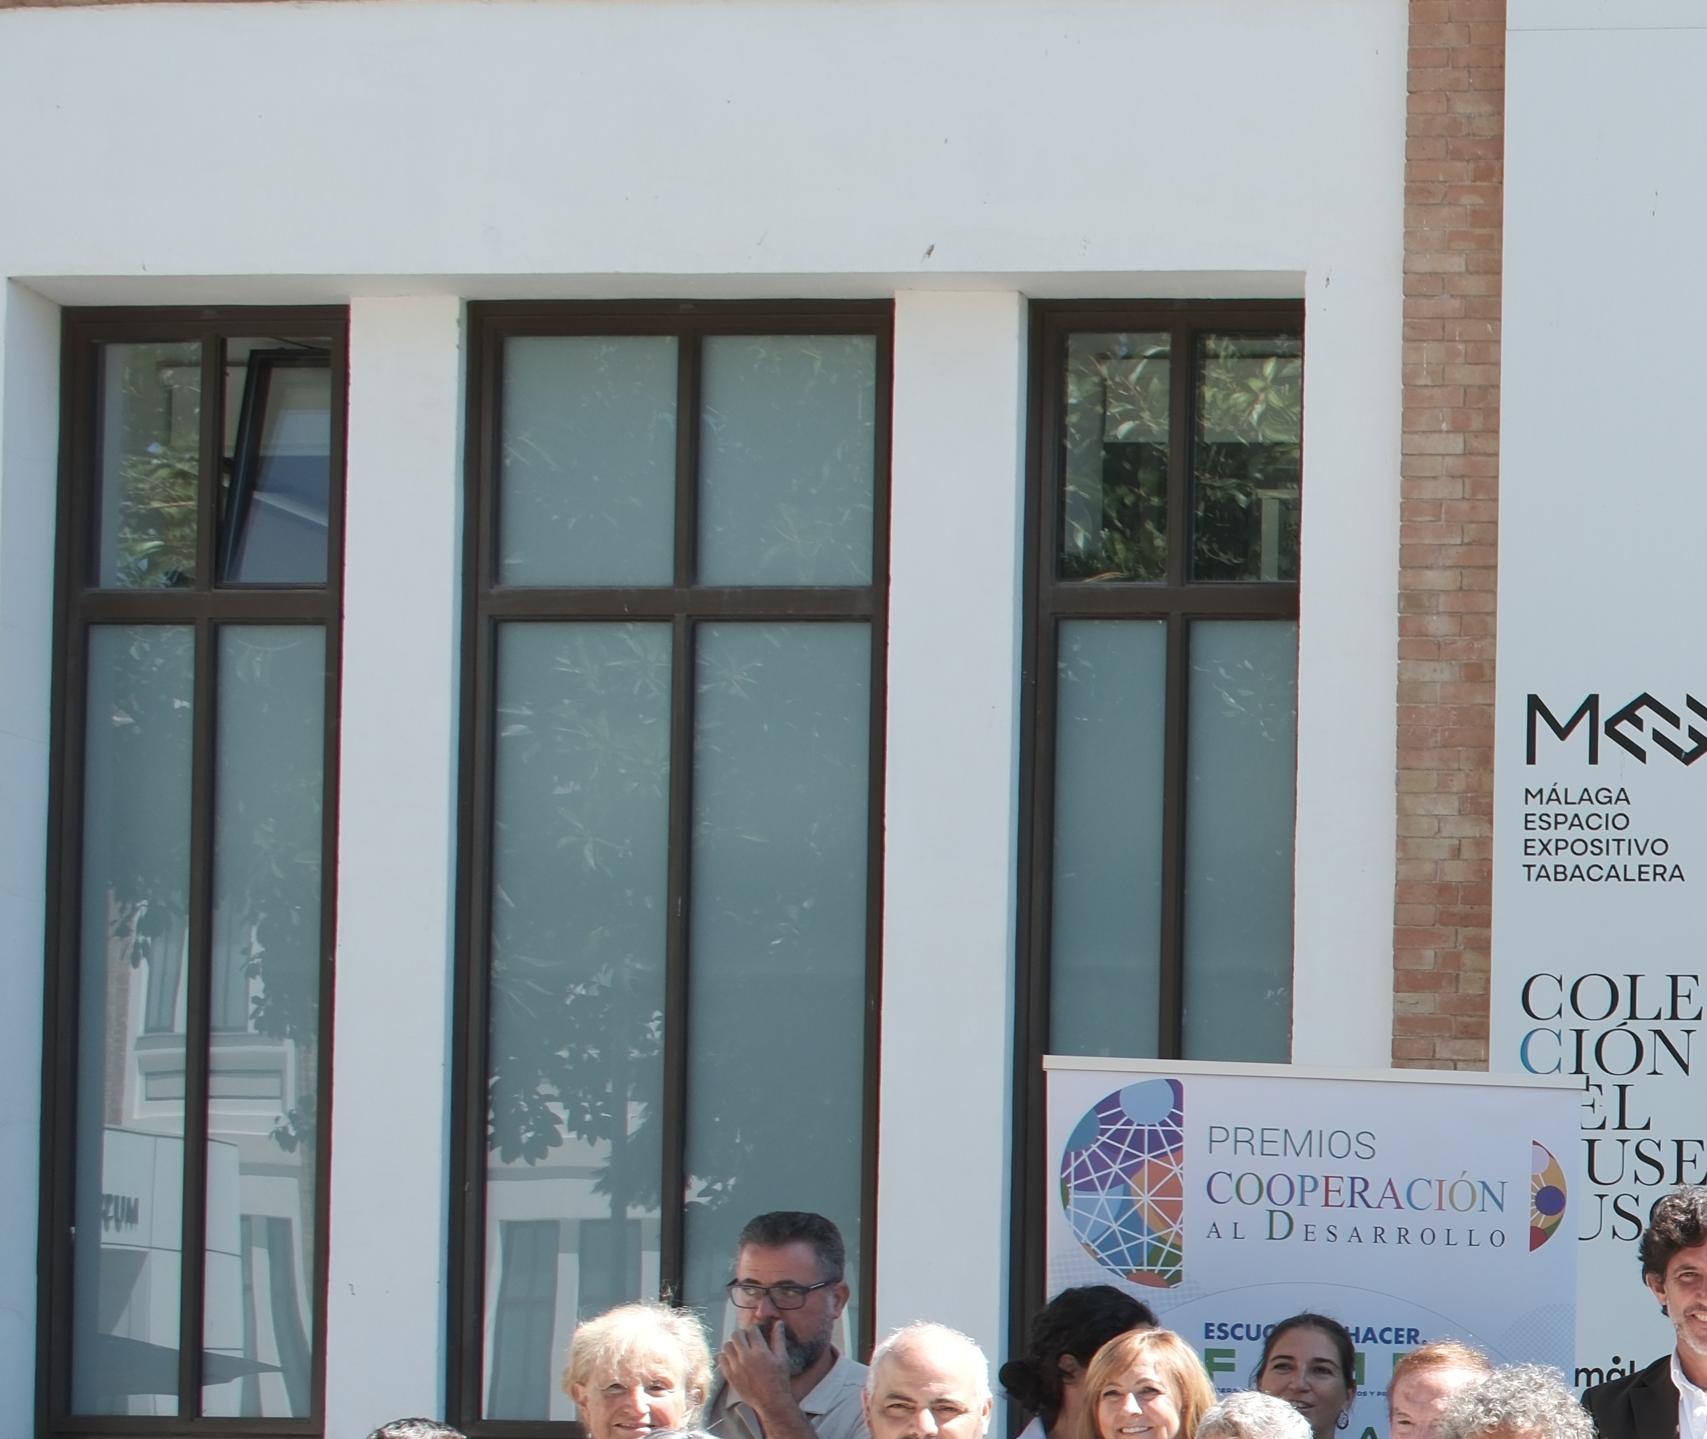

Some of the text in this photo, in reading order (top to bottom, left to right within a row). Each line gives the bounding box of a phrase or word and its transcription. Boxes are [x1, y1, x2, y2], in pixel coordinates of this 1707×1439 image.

[1524, 782, 1631, 806] MÁLAGA
[1524, 812, 1631, 831] ESPACIO
[1523, 837, 1669, 857] EXPOSITIVO
[1522, 863, 1686, 883] TABACALERA
[1520, 1022, 1697, 1077] CIÓN
[1581, 1083, 1651, 1130] EL
[1208, 1126, 1377, 1160] PREMIOS
[1206, 1171, 1508, 1214] COOPERACIÓN
[1207, 1209, 1507, 1248] AL DESARROLLO
